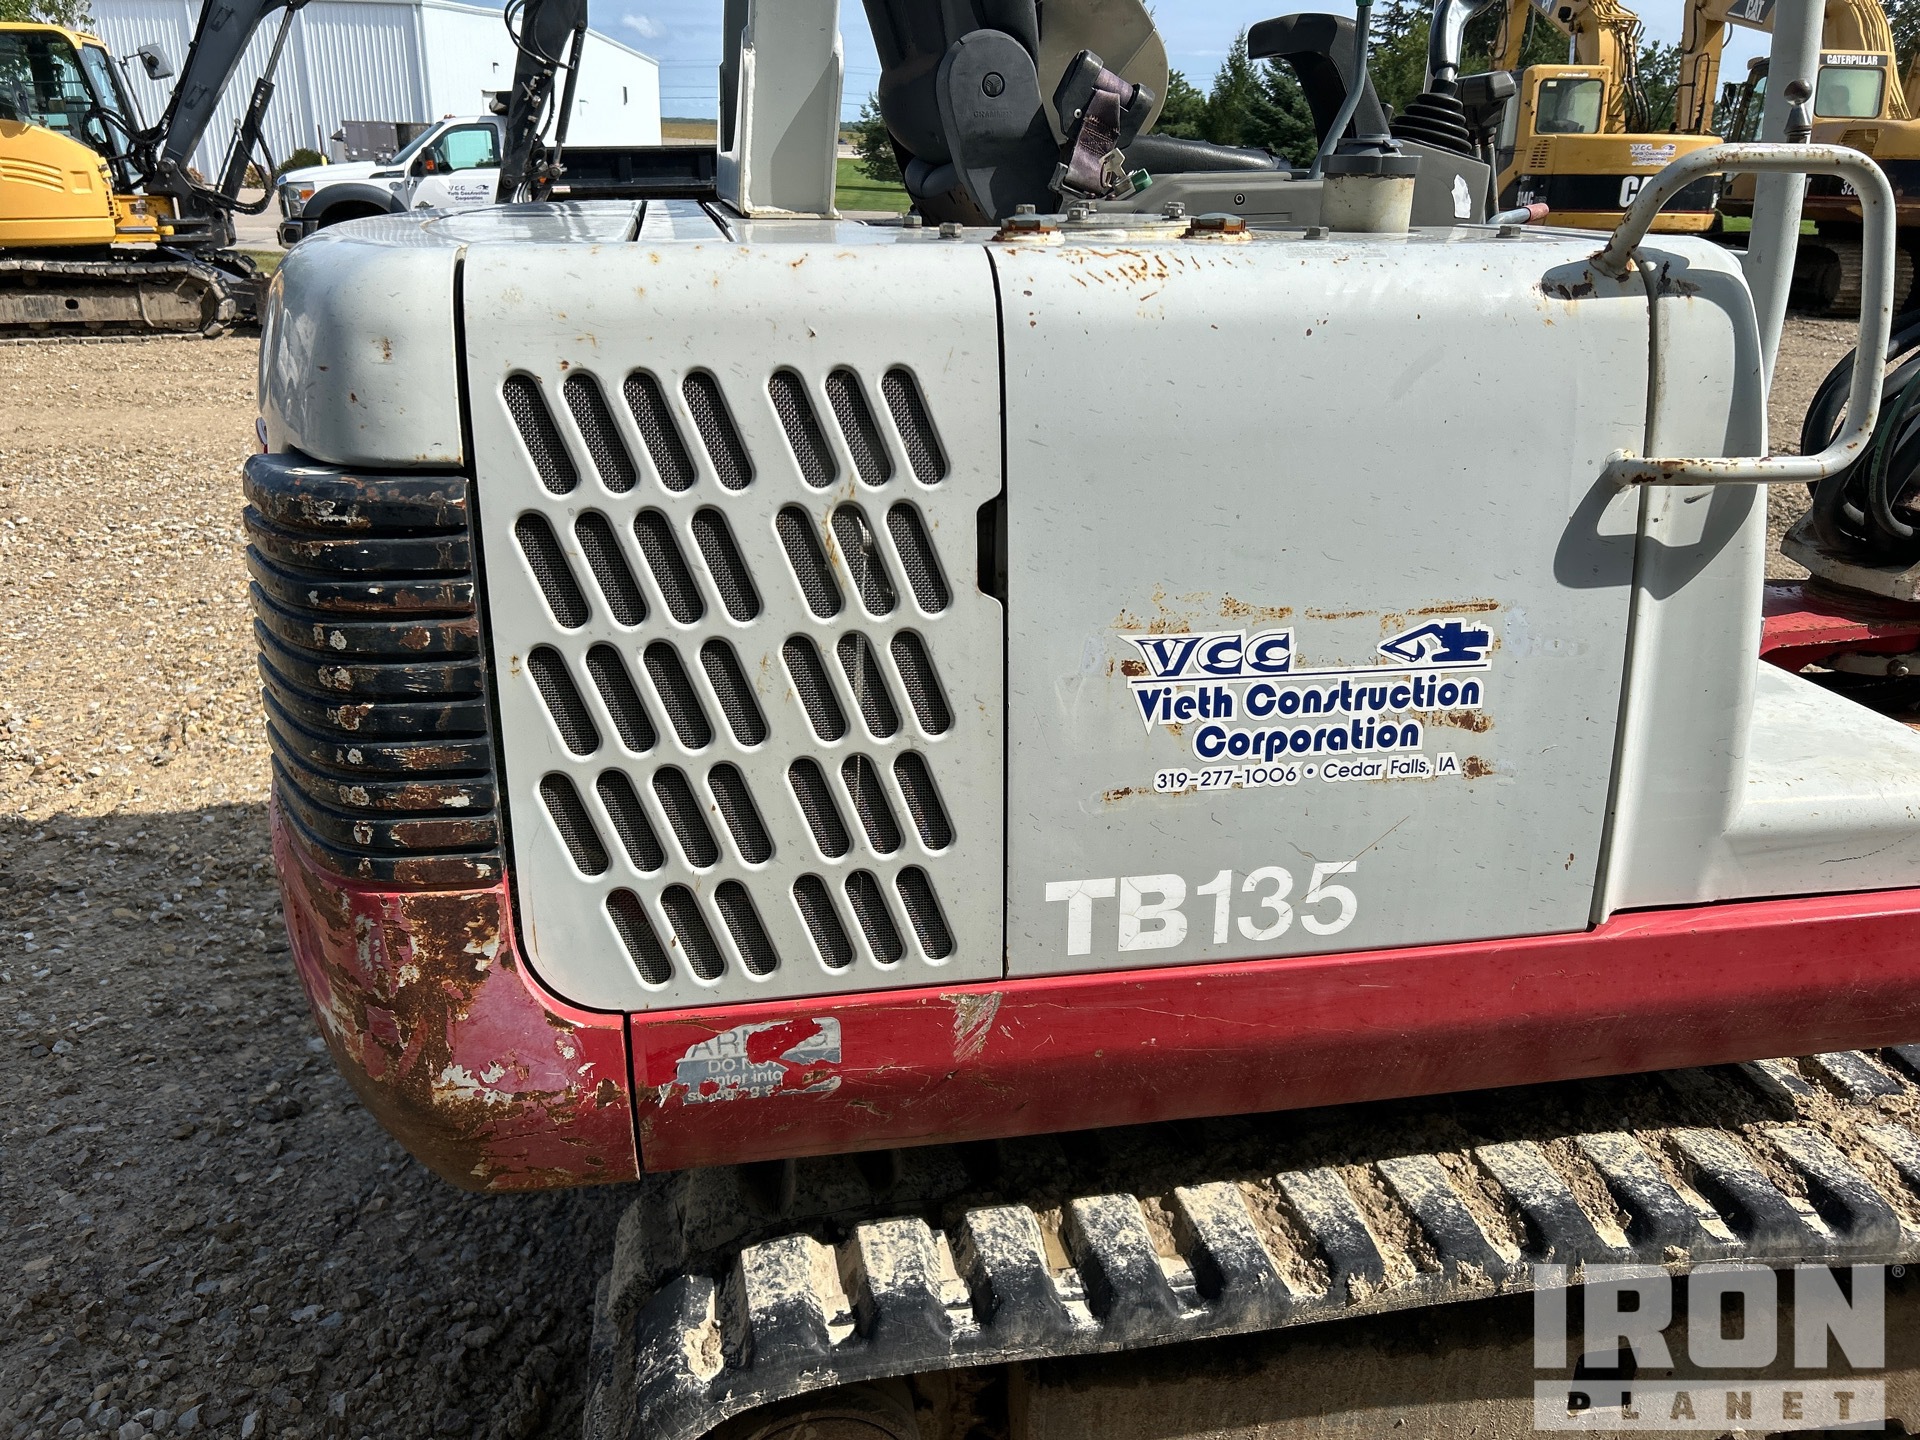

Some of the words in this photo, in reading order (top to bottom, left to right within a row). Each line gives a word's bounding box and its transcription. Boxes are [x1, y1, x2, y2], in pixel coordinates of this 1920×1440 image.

[1745, 0, 1766, 21] CAT
[1826, 54, 1878, 66] CATERPILLAR
[1134, 632, 1291, 677] VCC
[1137, 686, 1233, 722] Vieth
[1246, 674, 1480, 717] Construction
[1196, 717, 1419, 763] Corporation
[1157, 767, 1297, 789] 319-277-1006
[1323, 761, 1382, 778] Cedar
[1390, 757, 1430, 777] Falls,
[1439, 758, 1456, 772] IA
[1045, 860, 1358, 956] TB135
[708, 1058, 736, 1073] DO
[753, 1070, 783, 1083] into
